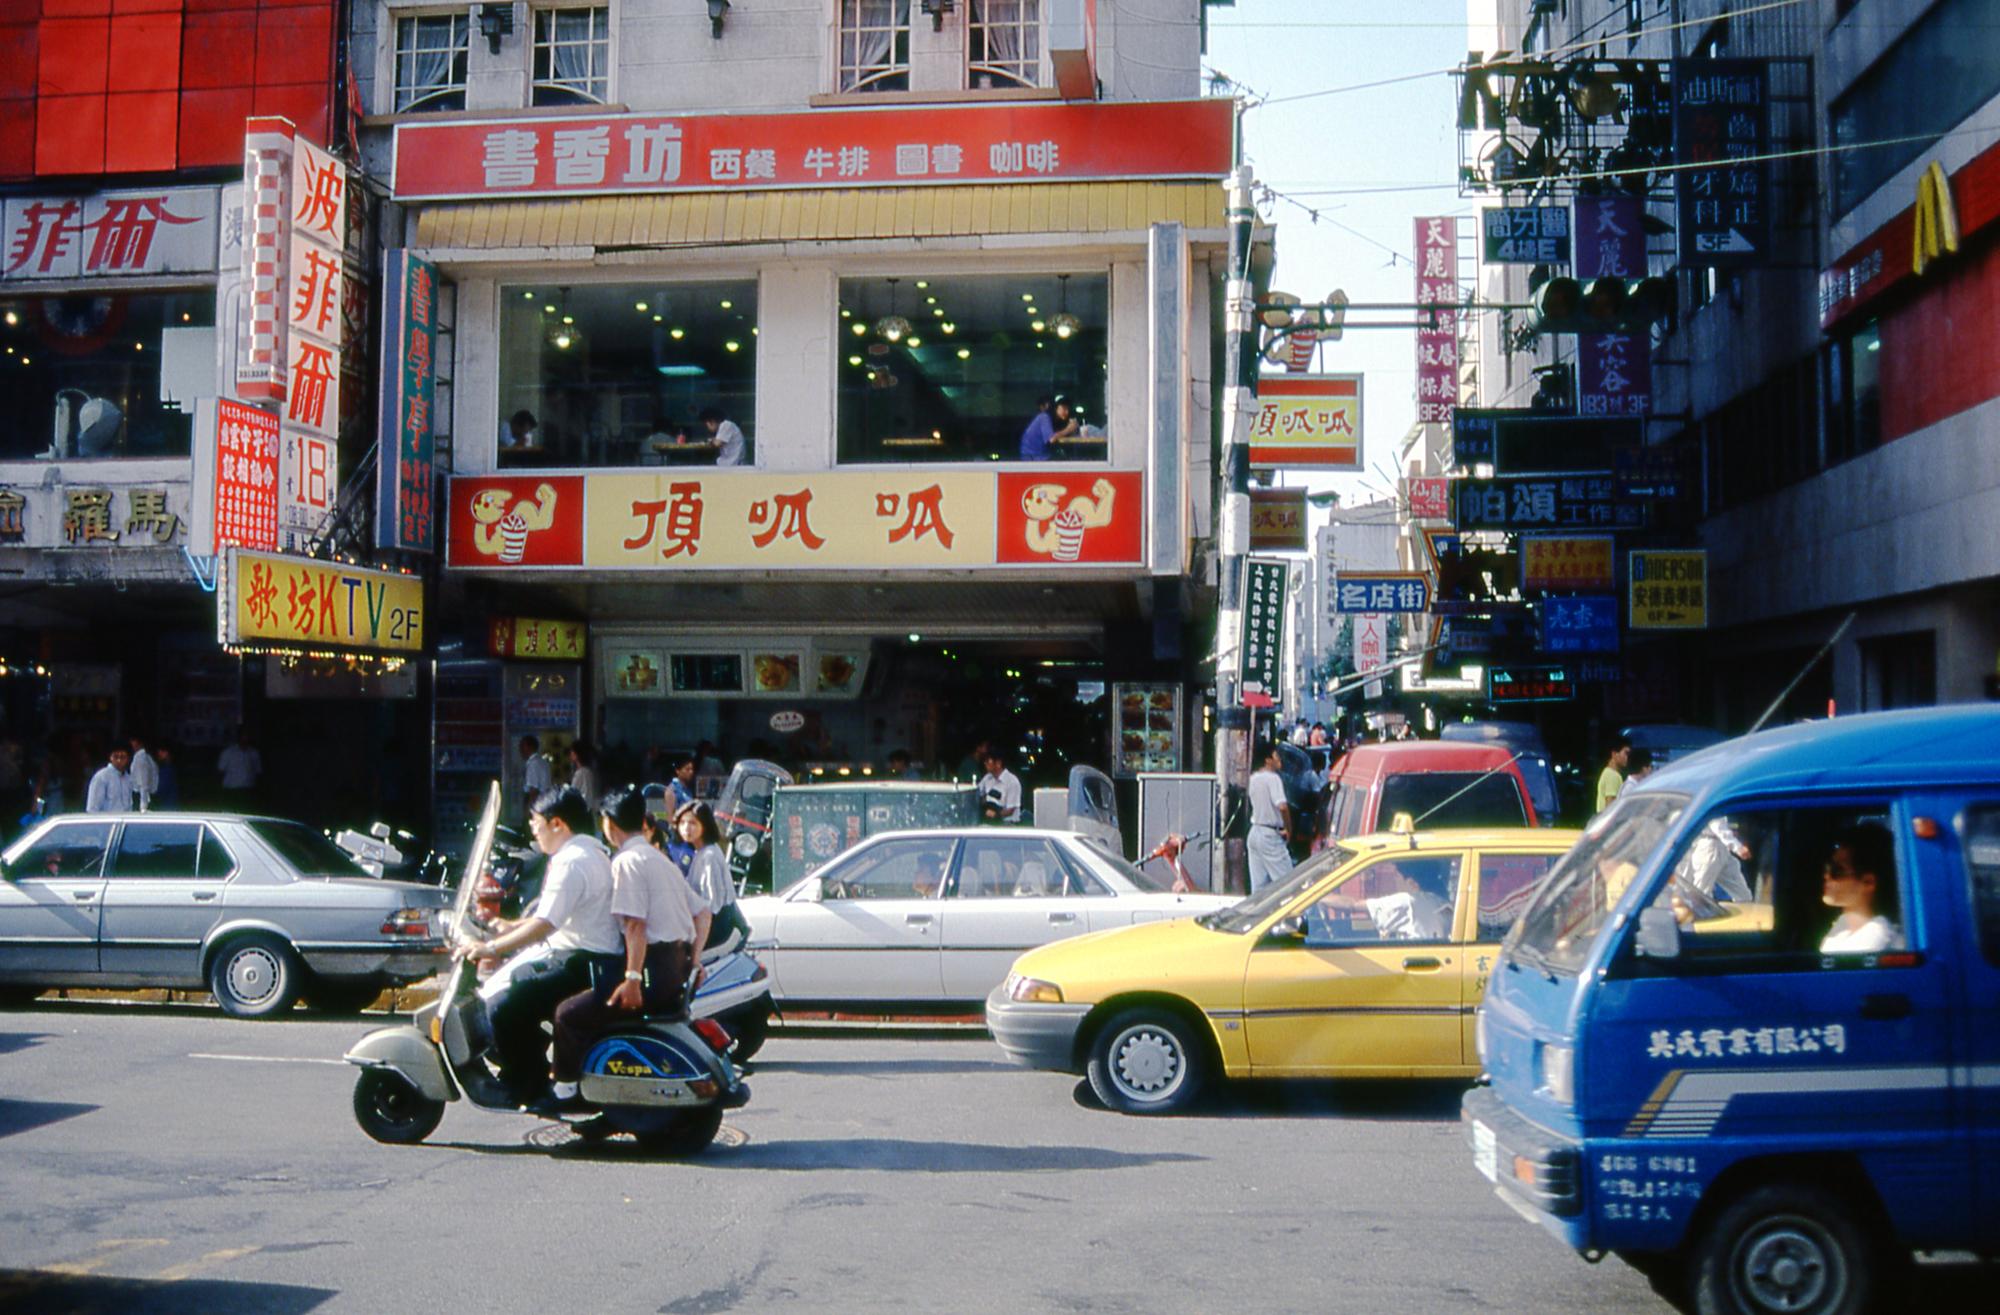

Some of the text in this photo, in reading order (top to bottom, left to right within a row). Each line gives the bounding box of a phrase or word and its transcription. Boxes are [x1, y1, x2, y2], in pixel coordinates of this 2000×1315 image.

[482, 123, 1060, 187] 書香坊 西餐 牛排 圖書 咖啡
[288, 145, 343, 428] 波菲爾
[297, 437, 326, 508] 18
[624, 481, 954, 559] 頂呱呱
[1461, 482, 1557, 523] 帕頌
[1340, 583, 1424, 609] 名店街
[390, 608, 419, 641] 2F
[607, 1060, 652, 1076] Vespa
